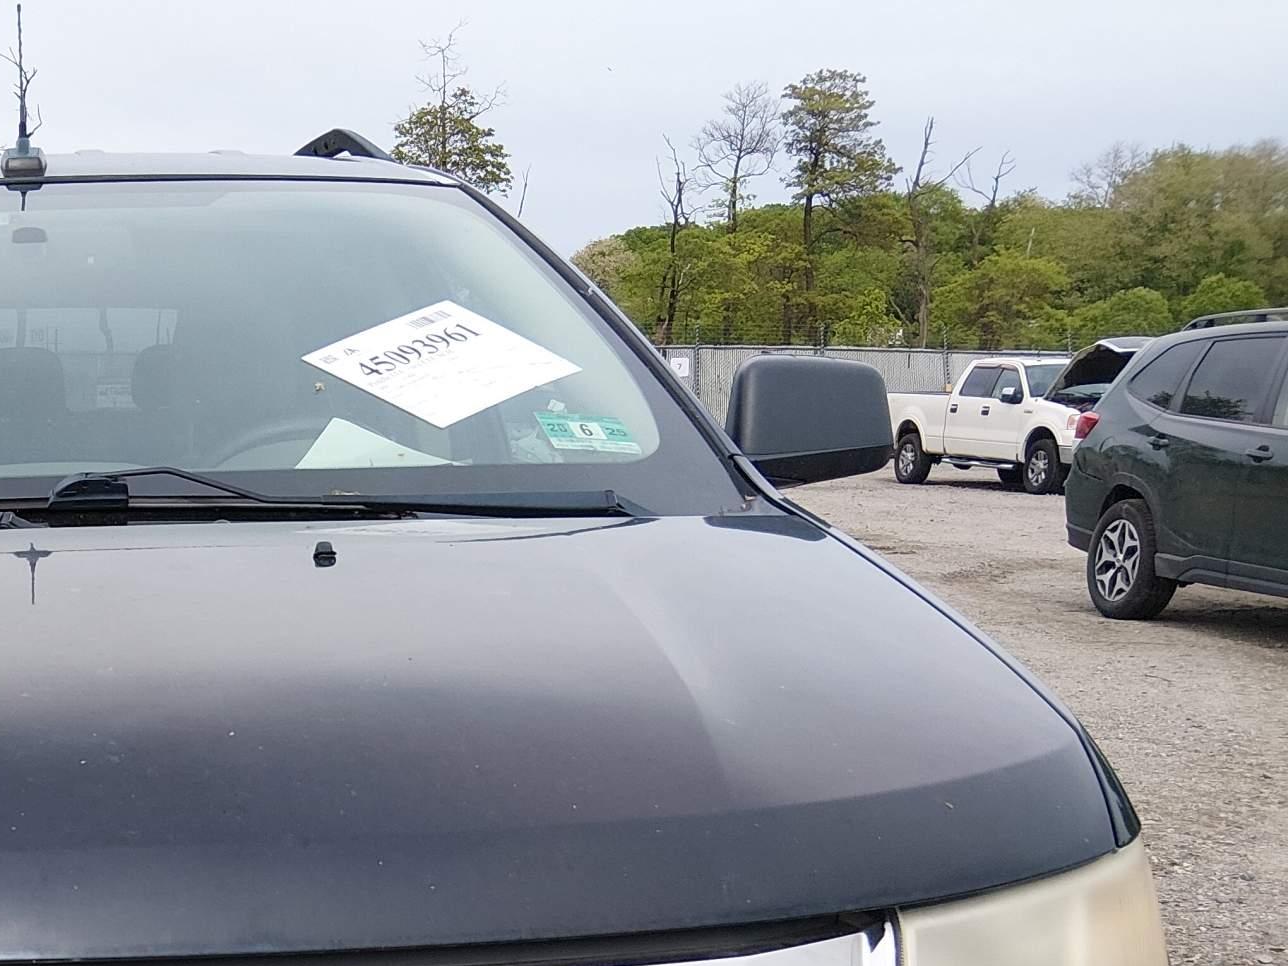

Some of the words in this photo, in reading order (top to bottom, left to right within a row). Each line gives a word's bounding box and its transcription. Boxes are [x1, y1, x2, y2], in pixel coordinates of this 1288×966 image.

[359, 324, 480, 376] 45093961
[547, 423, 568, 433] 20
[579, 423, 594, 437] 6
[605, 427, 626, 437] 25
